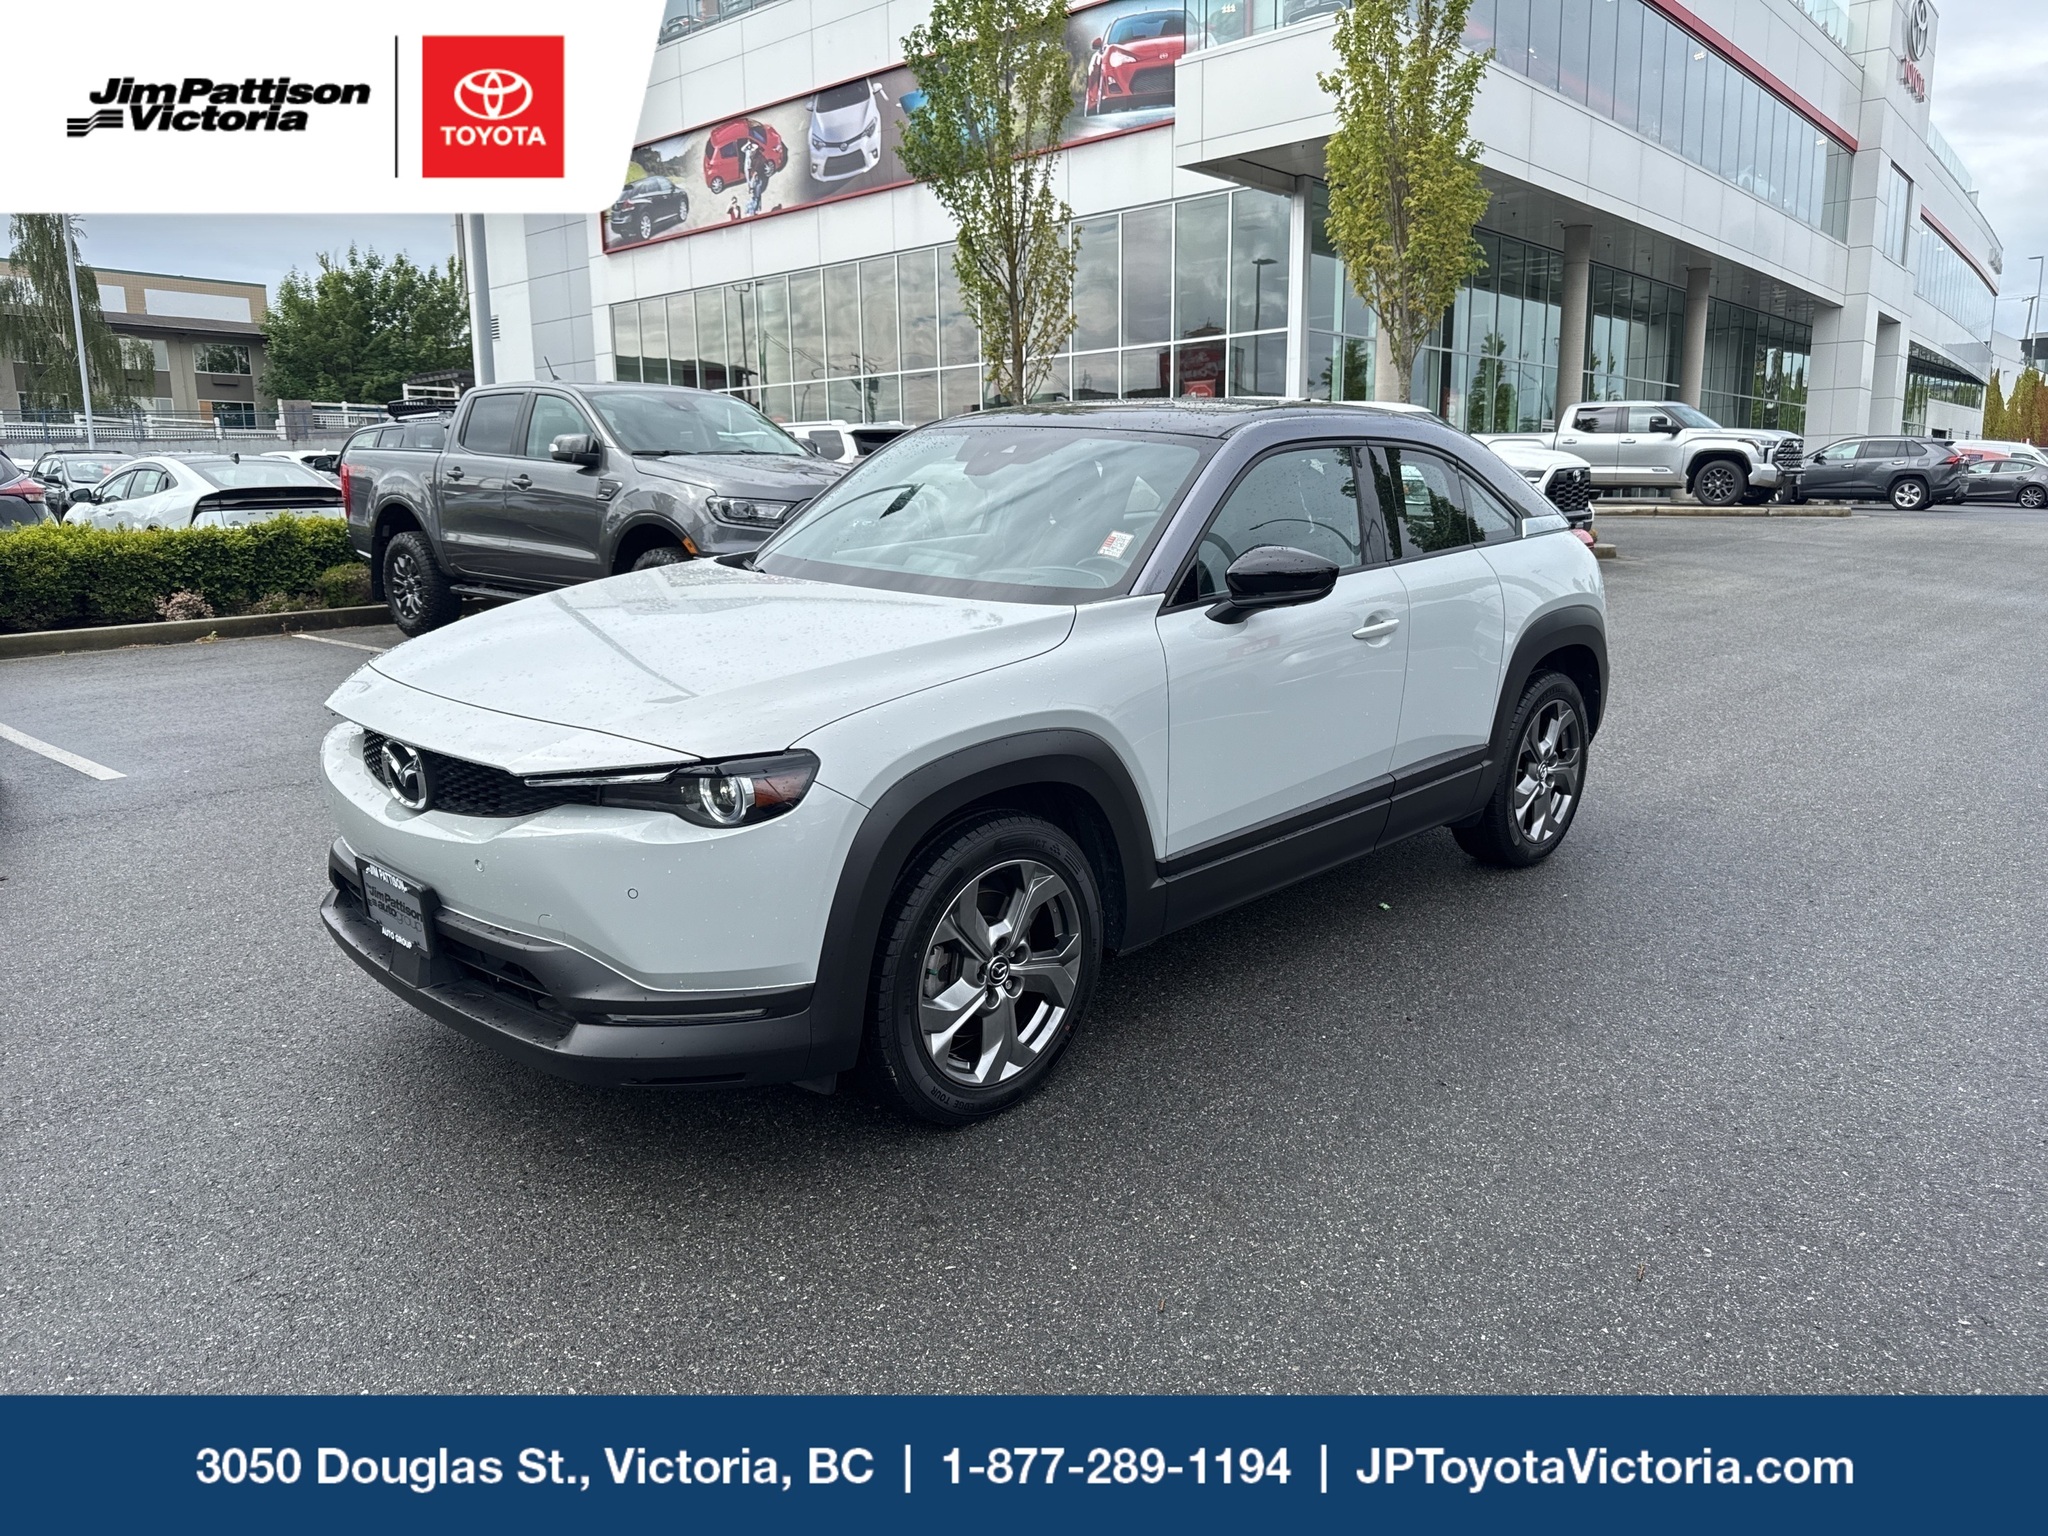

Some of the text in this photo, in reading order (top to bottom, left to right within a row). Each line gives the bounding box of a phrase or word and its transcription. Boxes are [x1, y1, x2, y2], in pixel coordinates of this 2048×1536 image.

[1900, 55, 1925, 103] TOYOTA
[930, 1086, 951, 1106] TOUR
[953, 1099, 975, 1111] EDGE
